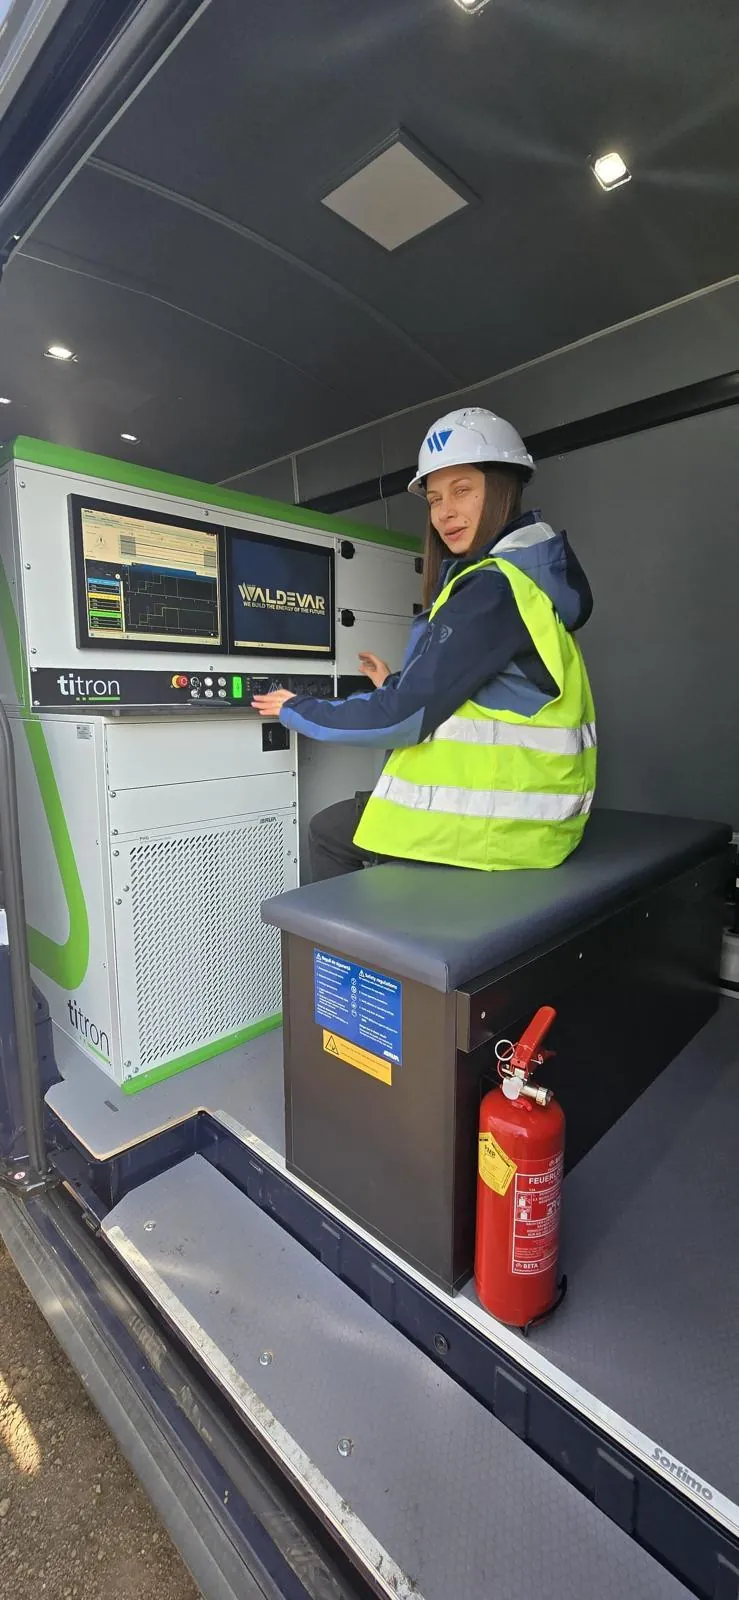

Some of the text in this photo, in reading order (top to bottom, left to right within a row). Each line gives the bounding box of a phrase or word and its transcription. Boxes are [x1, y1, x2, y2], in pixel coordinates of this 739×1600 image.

[238, 582, 325, 610] WALDEVAR
[57, 673, 120, 695] titron
[365, 973, 377, 982] Safety
[377, 978, 398, 989] regulations
[67, 1000, 110, 1057] titron
[652, 1447, 713, 1501] Sortimo
